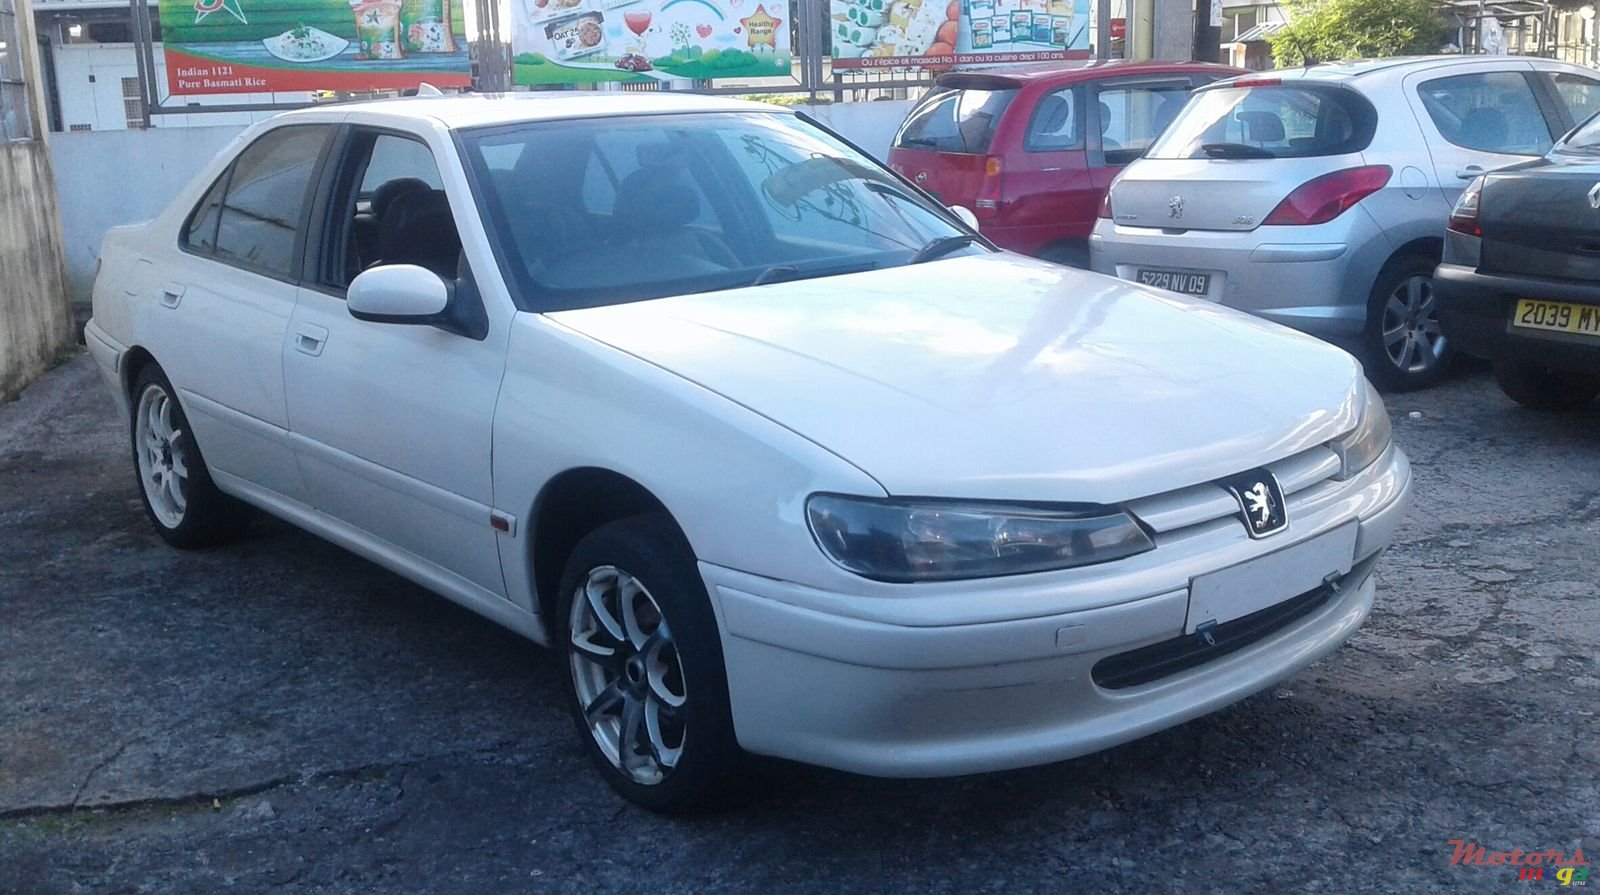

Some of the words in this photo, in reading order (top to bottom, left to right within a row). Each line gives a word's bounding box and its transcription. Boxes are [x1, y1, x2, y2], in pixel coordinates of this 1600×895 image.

[1019, 52, 1035, 61] depi
[1037, 52, 1050, 60] 100
[177, 67, 208, 76] Indian
[212, 66, 232, 75] 1121
[178, 79, 200, 88] Pure
[204, 78, 242, 87] Basmati
[244, 77, 266, 86] Rice
[1141, 271, 1170, 290] 5229
[1170, 273, 1187, 291] NV
[1188, 275, 1205, 293] 09
[1522, 303, 1572, 327] 2039
